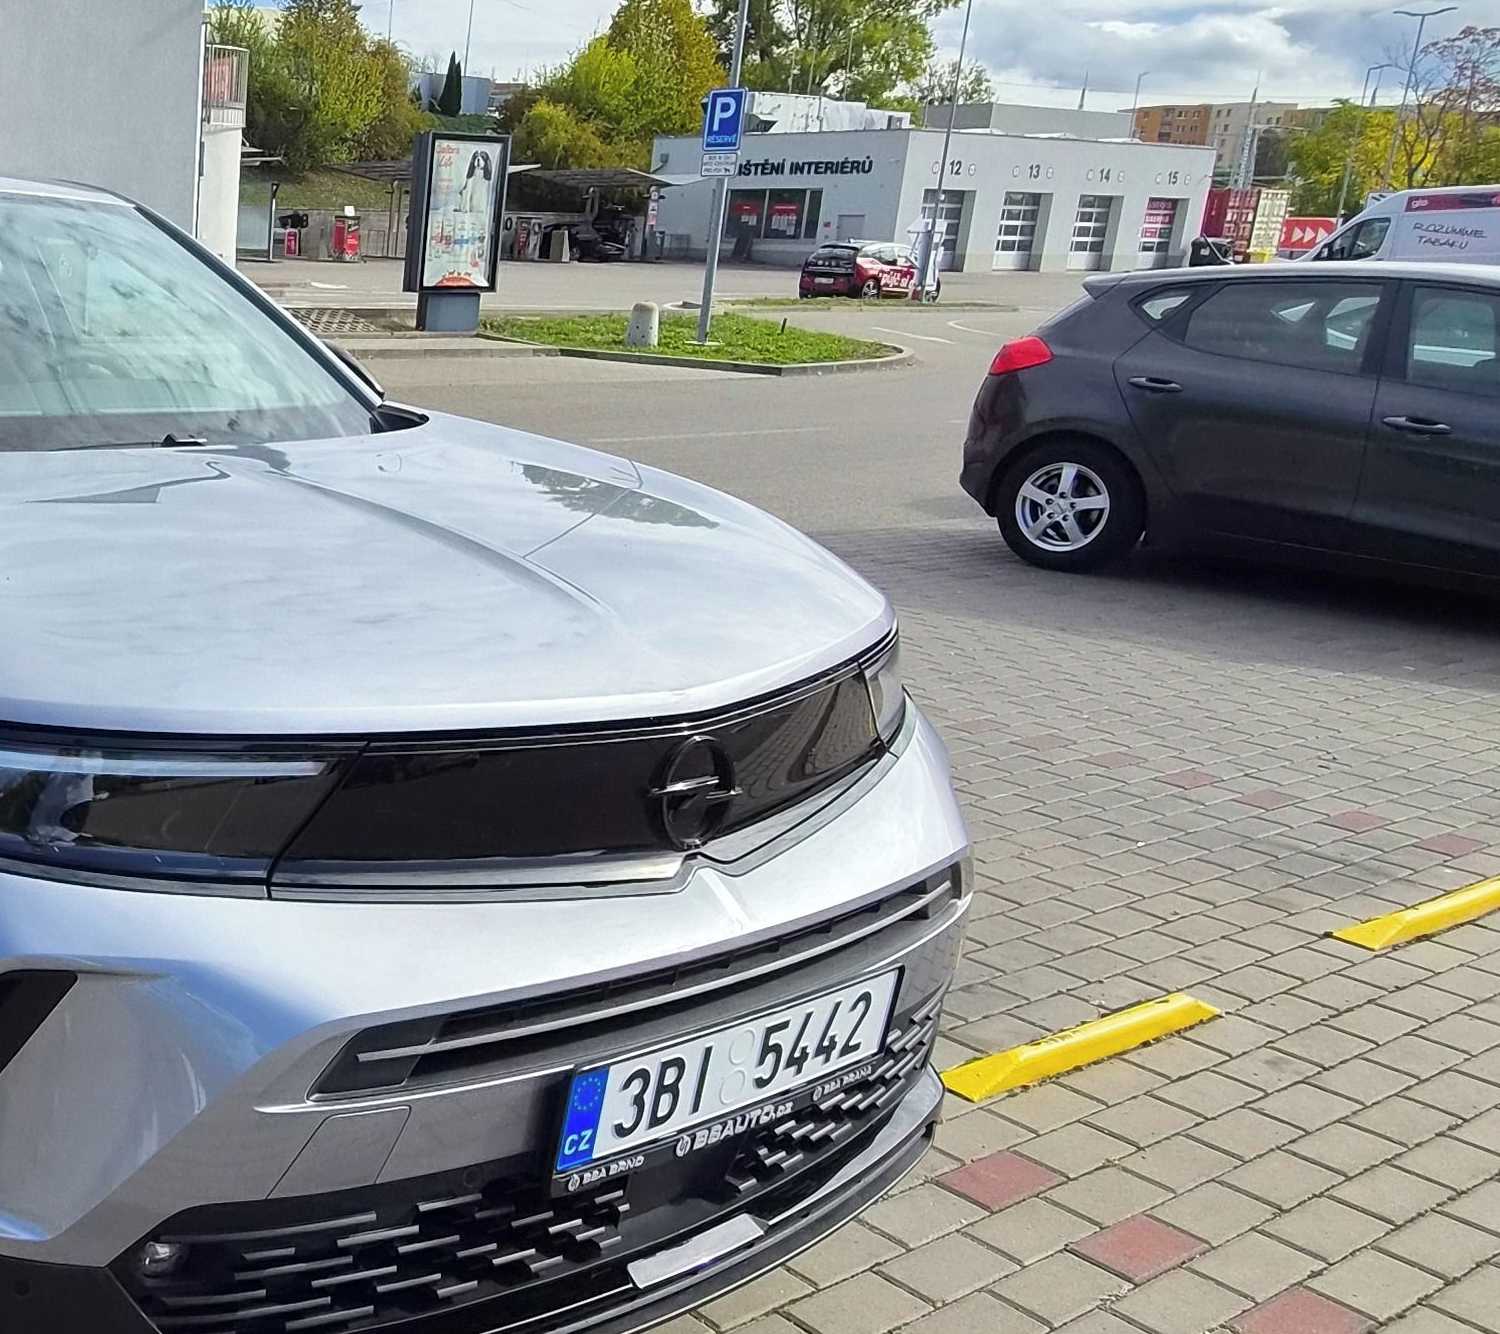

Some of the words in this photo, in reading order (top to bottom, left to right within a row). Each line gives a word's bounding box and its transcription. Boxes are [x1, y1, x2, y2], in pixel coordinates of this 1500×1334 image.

[712, 97, 736, 132] P
[738, 158, 786, 176] IŠTĚNÍ
[789, 155, 874, 175] INTERIÉRŮ
[949, 160, 962, 176] 12
[1028, 164, 1040, 179] 13
[1099, 168, 1111, 182] 14
[1167, 171, 1179, 185] 15
[753, 990, 872, 1089] 5442
[563, 1129, 593, 1155] CZ
[582, 1166, 607, 1185] BBA
[609, 1155, 645, 1174] BRNO
